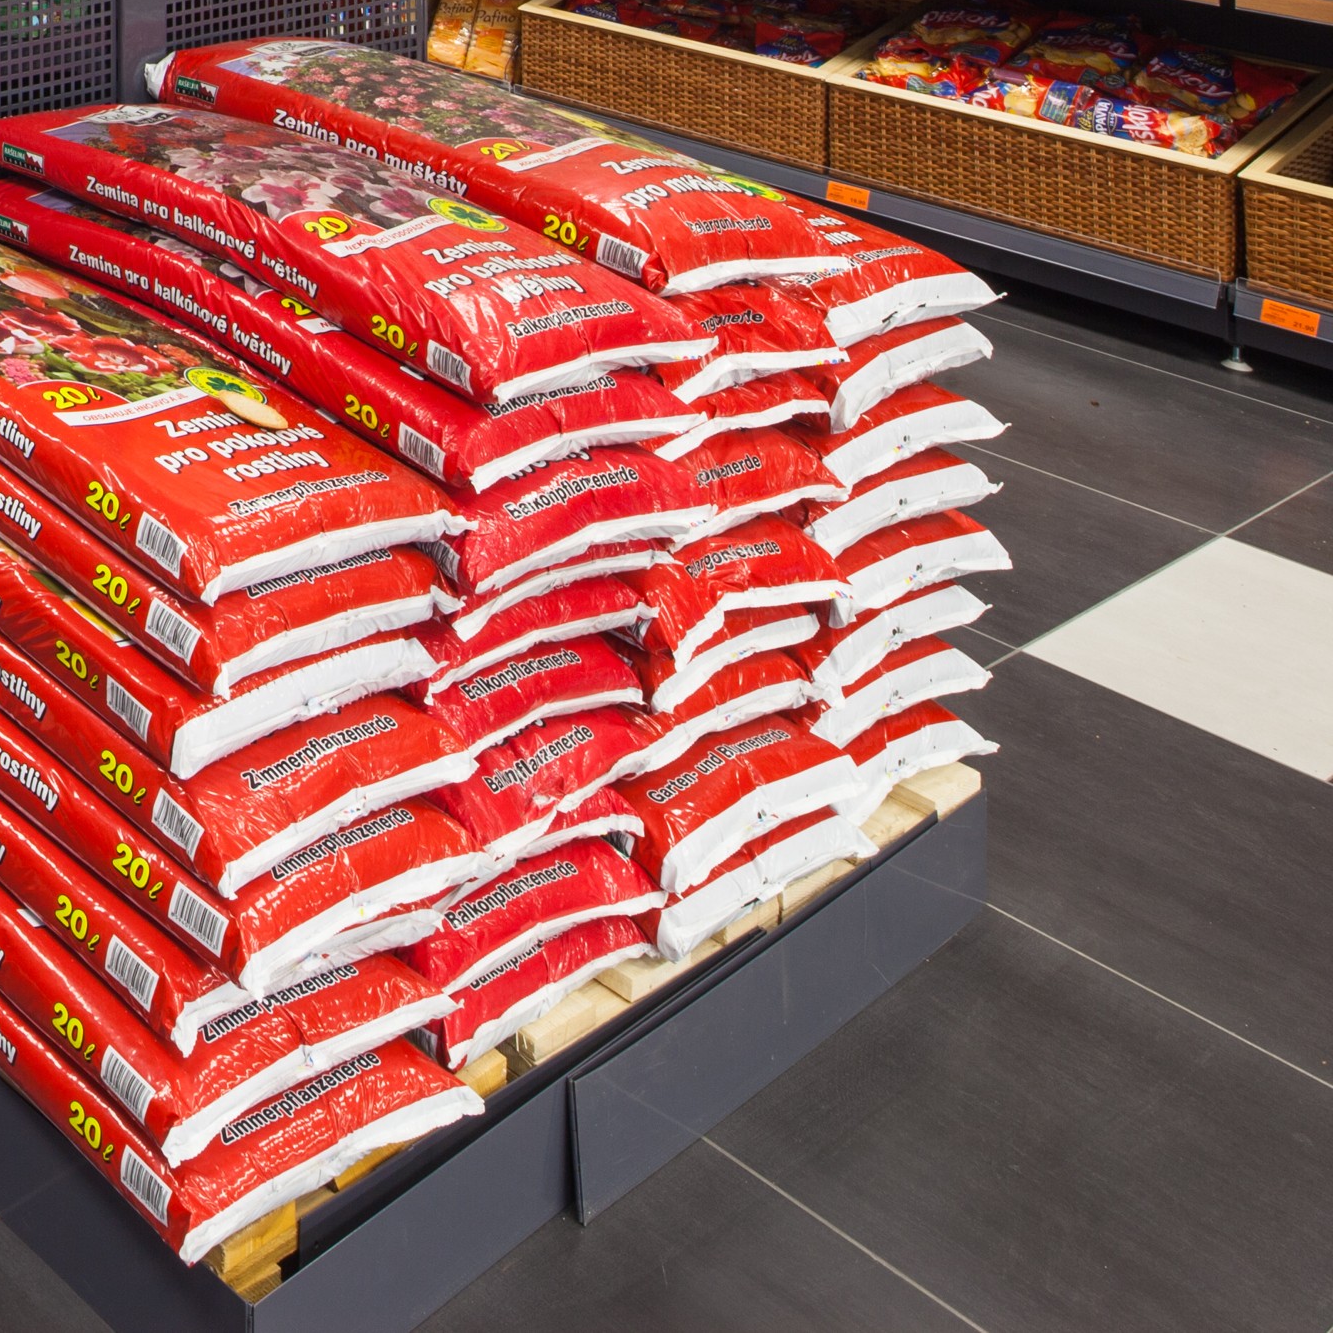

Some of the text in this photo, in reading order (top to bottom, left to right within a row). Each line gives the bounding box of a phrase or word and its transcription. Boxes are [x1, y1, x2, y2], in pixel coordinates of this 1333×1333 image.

[272, 107, 339, 147] Zemina
[343, 135, 378, 160] pro
[384, 151, 469, 197] muškáty
[86, 175, 139, 209] Zemina
[142, 198, 170, 221] pro
[173, 207, 256, 260] balkónové
[620, 180, 670, 209] pro
[421, 237, 519, 266] Zemina
[544, 214, 577, 246] 20
[424, 249, 583, 299] pro balkónové
[371, 314, 405, 350] 20
[43, 386, 88, 411] 20
[153, 408, 245, 440] Zemin
[154, 421, 326, 475] pro pokojové
[223, 446, 331, 484] rostliny
[85, 480, 121, 521] 20
[228, 468, 390, 516] Zimmerpflanzenerde
[459, 647, 581, 702] Balkonpflanzenerde
[240, 713, 399, 793] Zimmerpflanzenerde
[648, 726, 790, 804] Garten- und Blumenerde
[112, 842, 151, 889] 20
[444, 858, 579, 931] Balkonpflanzenerde
[219, 1050, 382, 1146] Zimmerpflanzenerde
[68, 1100, 103, 1151] 20
